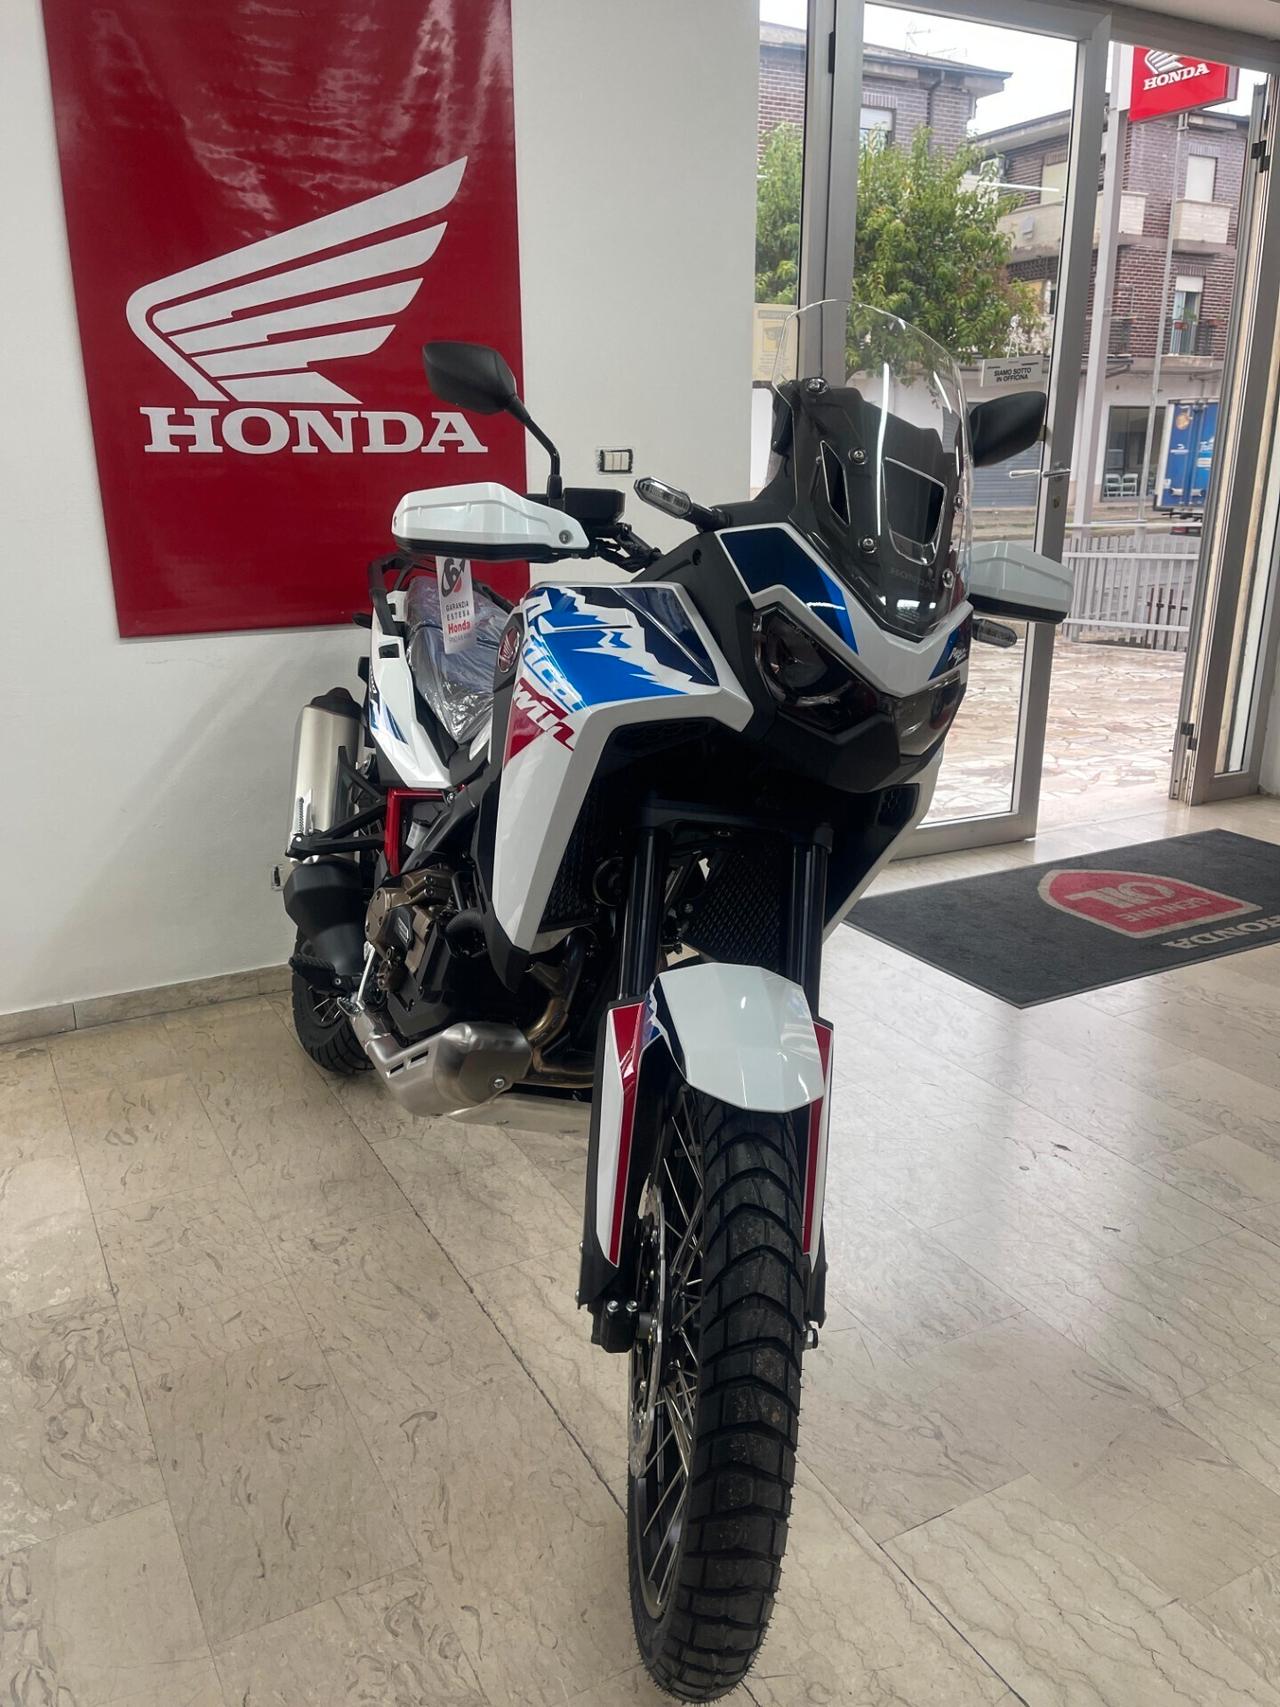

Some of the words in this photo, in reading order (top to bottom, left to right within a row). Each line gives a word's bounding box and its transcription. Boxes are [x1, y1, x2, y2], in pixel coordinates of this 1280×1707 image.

[1143, 63, 1210, 90] HONDA
[139, 406, 488, 454] HONDA
[445, 600, 469, 612] GARANZIA
[447, 611, 470, 622] ESTESA
[447, 620, 471, 634] Honda
[1118, 898, 1210, 922] GENUINE
[1162, 915, 1280, 949] HONDA
